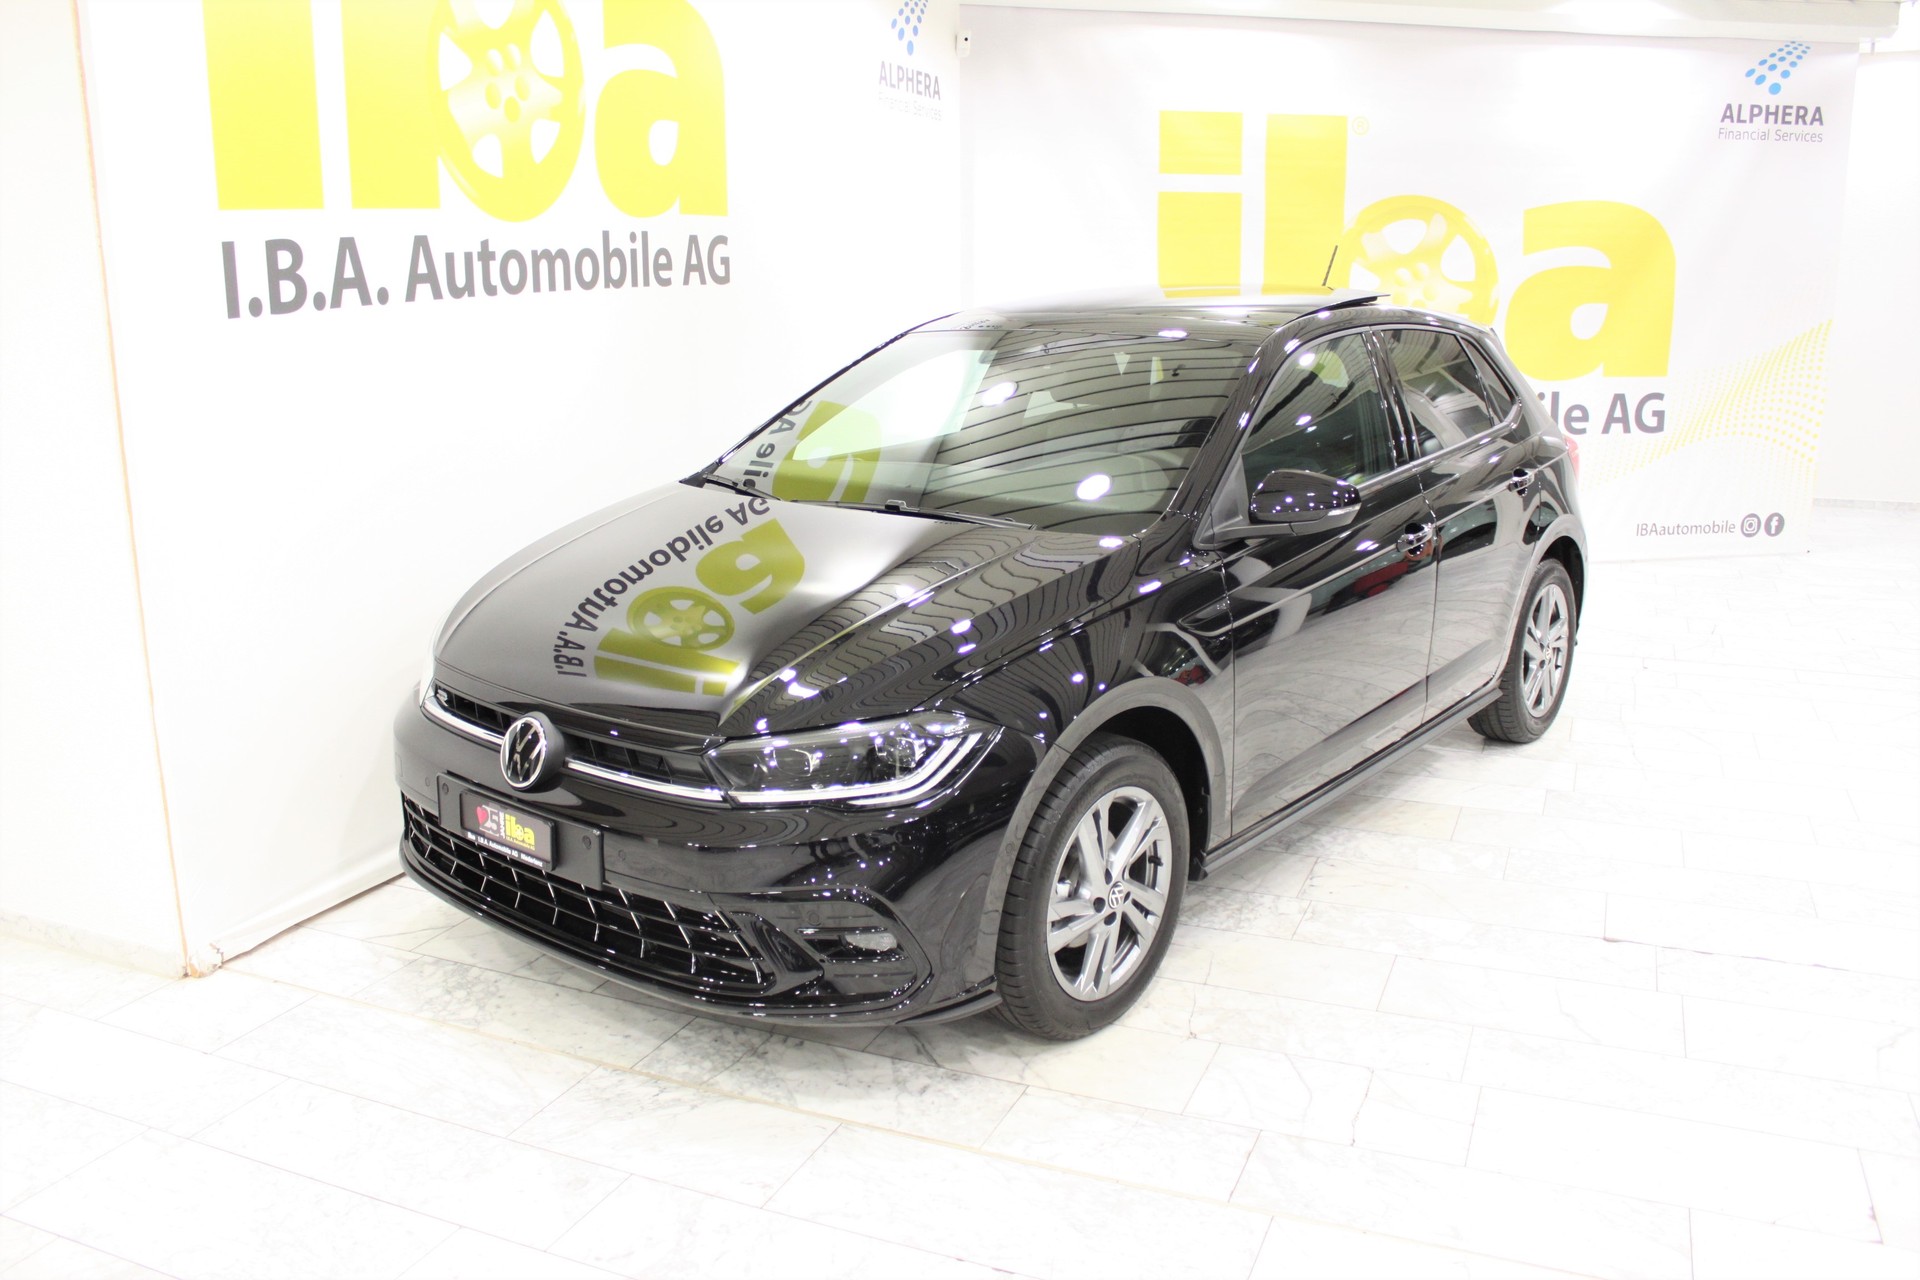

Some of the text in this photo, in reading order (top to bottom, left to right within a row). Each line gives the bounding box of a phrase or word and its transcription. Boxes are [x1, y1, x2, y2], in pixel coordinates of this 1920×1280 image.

[879, 60, 941, 101] ALPHERA
[1720, 103, 1824, 126] ALPHERA
[1718, 127, 1823, 143] Financial Services
[221, 230, 731, 319] I.B.A. Automobile AG
[1601, 392, 1665, 434] AG
[1636, 520, 1736, 537] IBAautomobile
